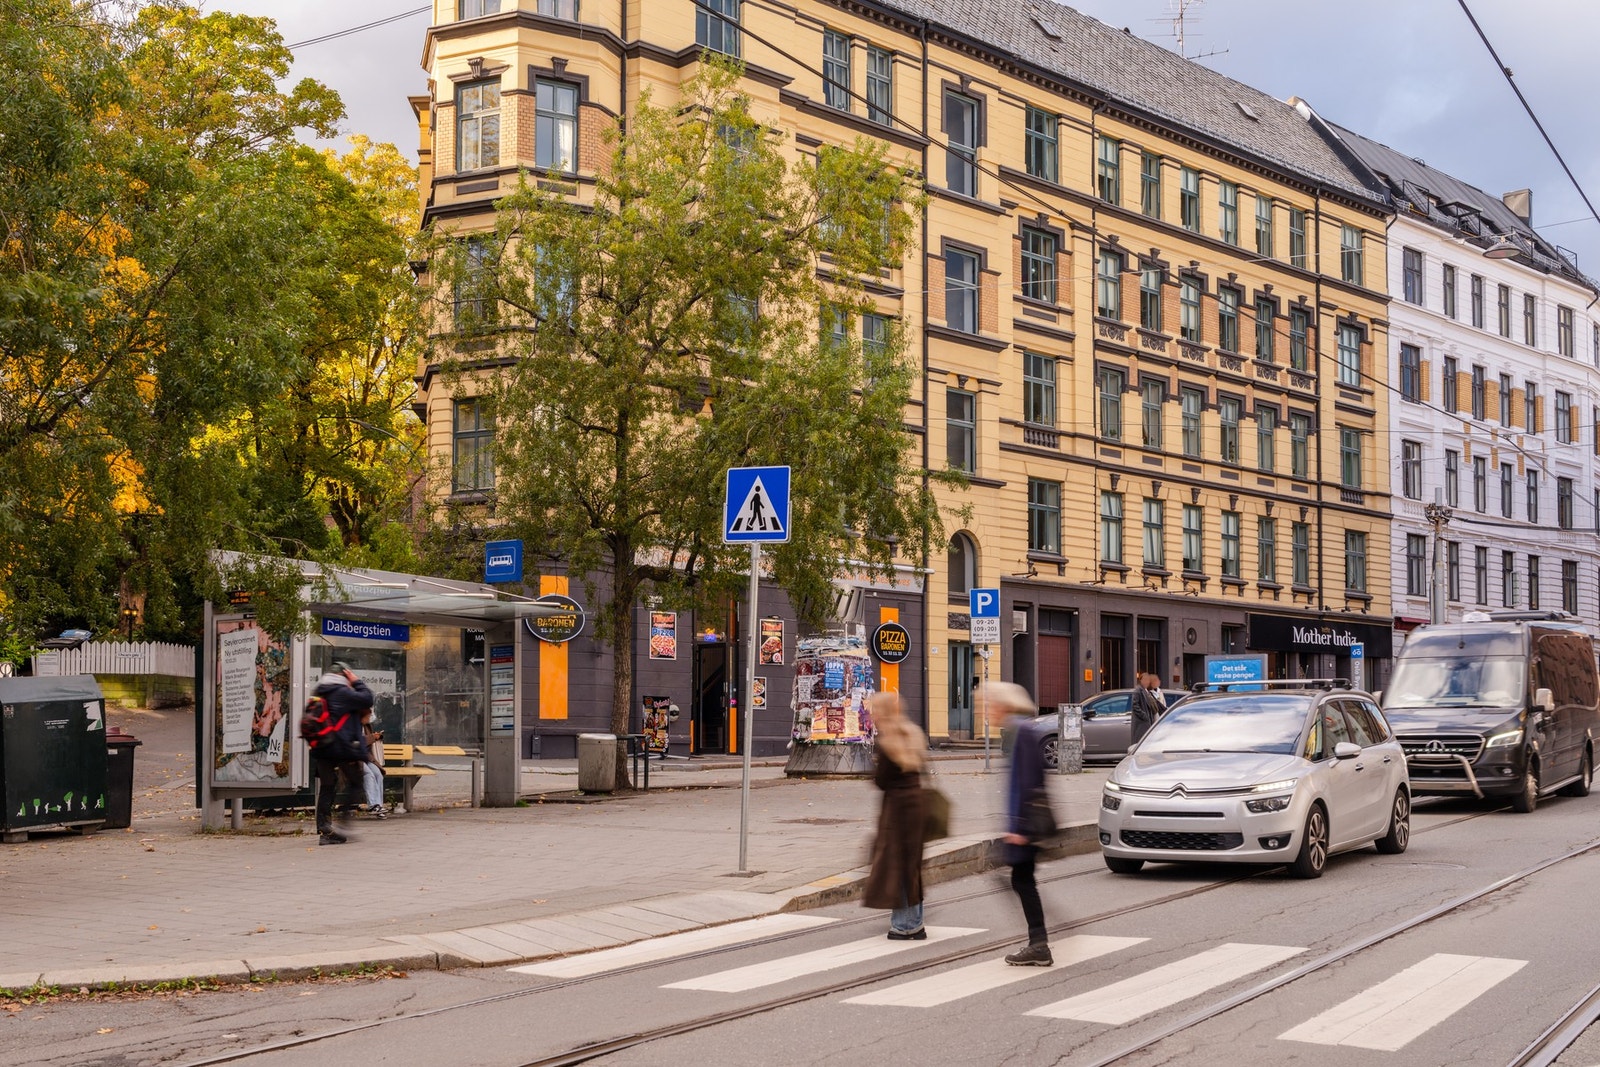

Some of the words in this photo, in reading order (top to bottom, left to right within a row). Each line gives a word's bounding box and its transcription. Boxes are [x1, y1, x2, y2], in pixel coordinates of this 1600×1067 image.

[977, 592, 993, 615] P
[326, 620, 391, 638] Dalsbergstien
[224, 636, 256, 647] Søylerommet
[880, 630, 906, 644] PIZZA
[1292, 625, 1332, 646] Mother
[1332, 629, 1357, 647] India
[224, 649, 232, 657] Ny
[231, 646, 252, 656] utstilling
[881, 643, 905, 651] BARONEN
[1234, 663, 1248, 671] står
[1232, 672, 1255, 680] penger
